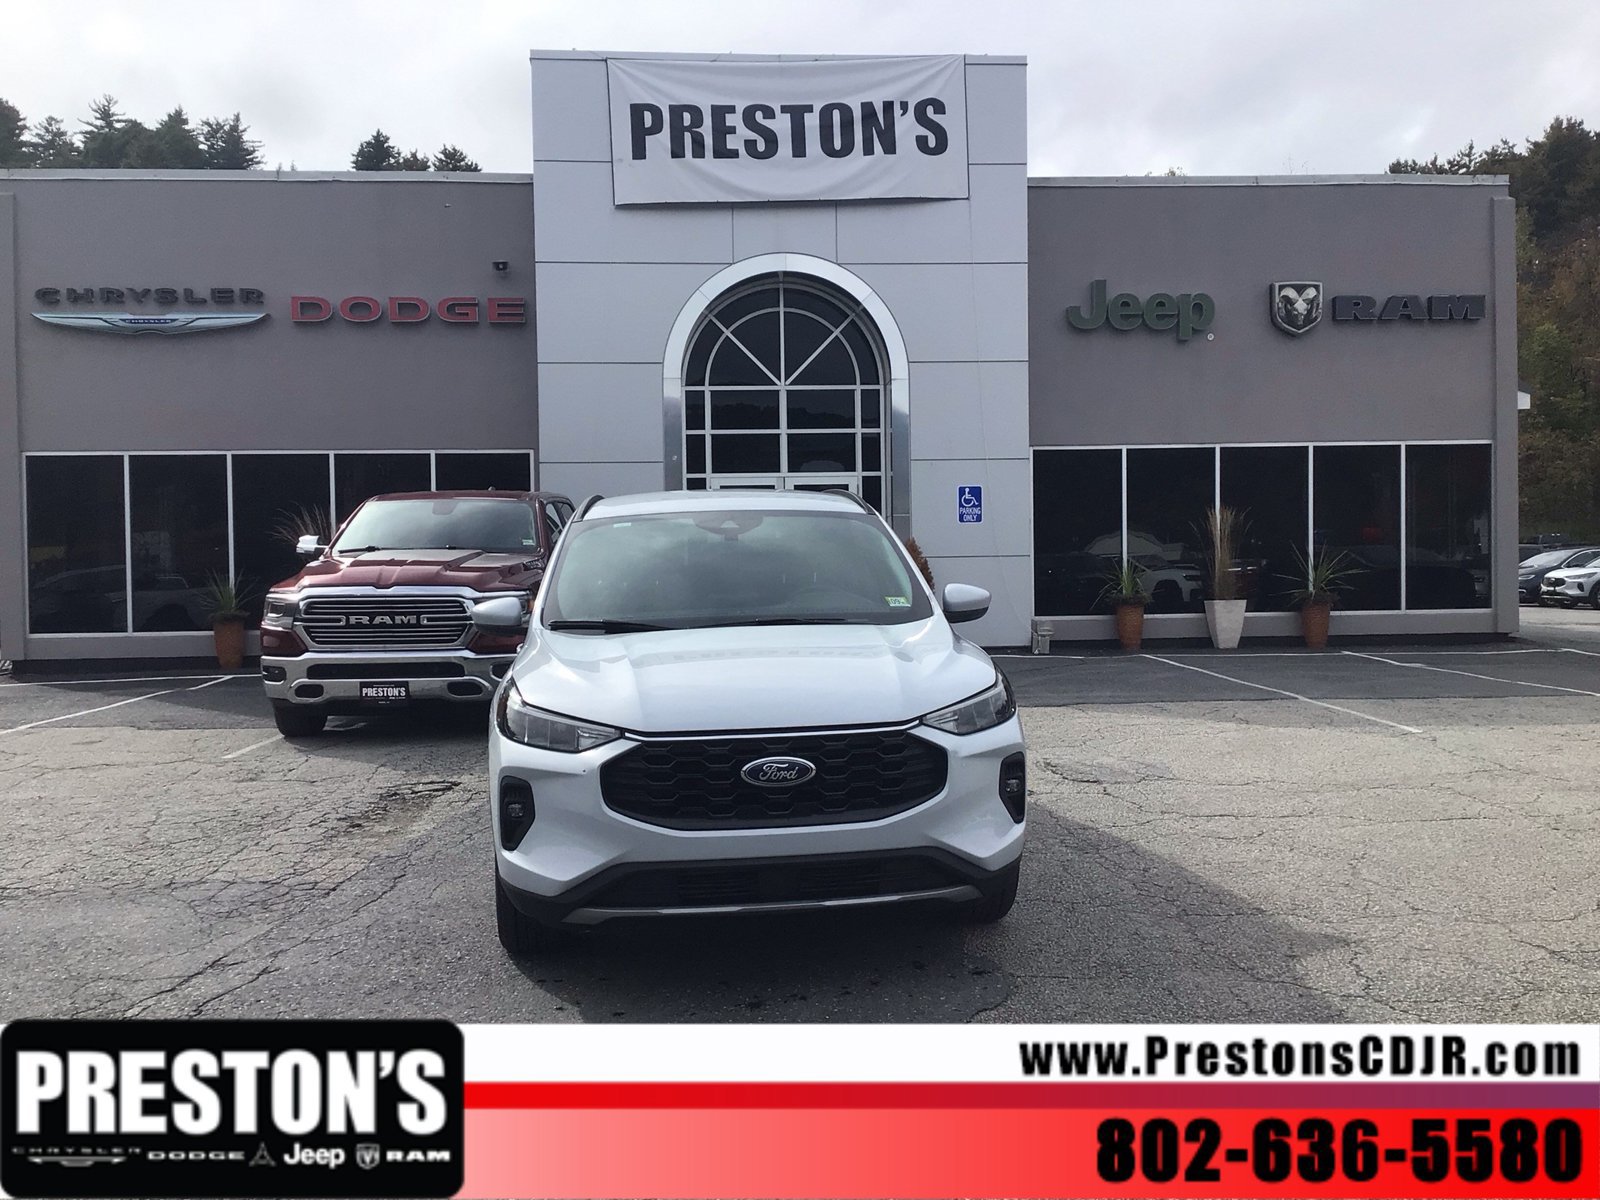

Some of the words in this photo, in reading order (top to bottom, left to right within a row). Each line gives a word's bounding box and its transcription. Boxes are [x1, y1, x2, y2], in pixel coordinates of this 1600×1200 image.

[629, 97, 949, 160] PRESTON'S
[34, 287, 265, 305] CHRYSLER
[290, 295, 526, 323] DODGE
[1066, 279, 1216, 342] Jeep
[1332, 294, 1487, 322] RAM
[349, 615, 417, 625] RAM
[362, 687, 406, 697] PRESTON'S
[758, 763, 799, 781] Ford
